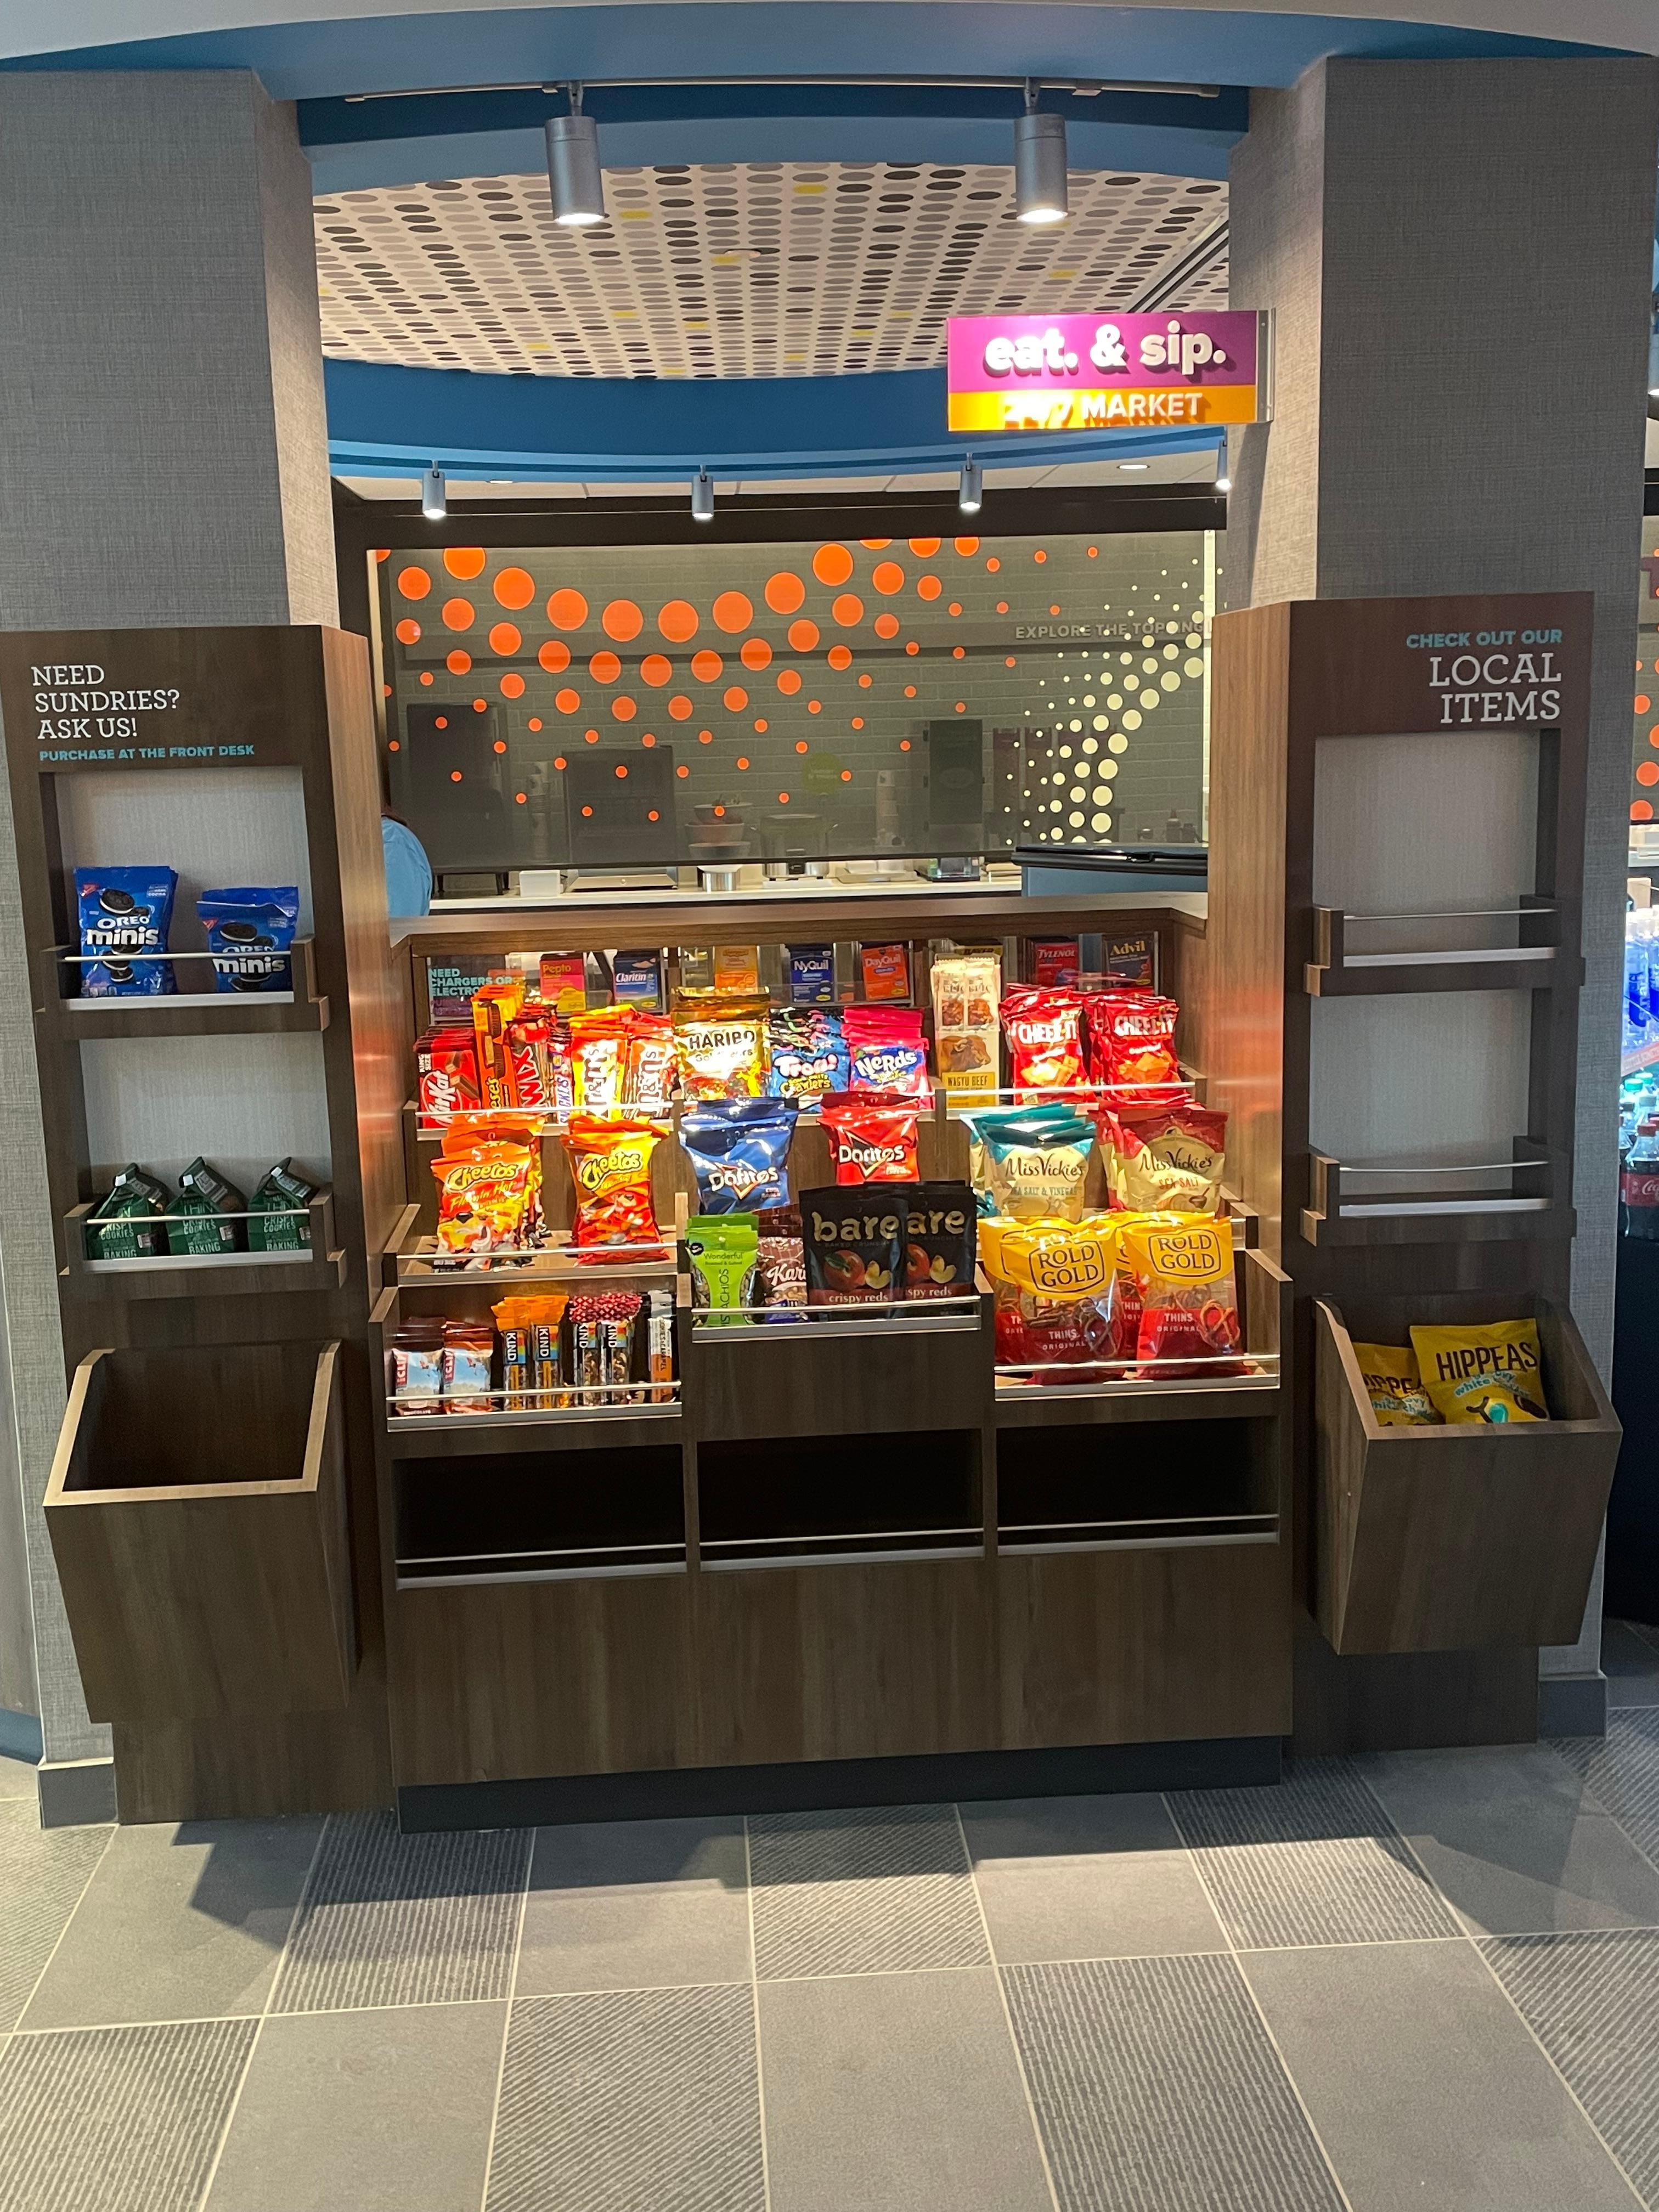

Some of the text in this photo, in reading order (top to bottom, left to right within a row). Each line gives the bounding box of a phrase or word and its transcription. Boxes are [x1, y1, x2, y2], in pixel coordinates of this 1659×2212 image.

[985, 320, 1227, 375] eat. & sip.
[1081, 392, 1203, 419] MARKET
[1015, 624, 1091, 640] EXPLORE
[1096, 623, 1127, 637] THE
[1406, 628, 1564, 649] CHECK OUT OUR
[31, 664, 105, 686] NEED
[1429, 652, 1562, 687] LOCAL
[35, 689, 180, 713] SUNDRIES?
[1440, 689, 1561, 724] ITEMS
[37, 717, 138, 740] ASK US!
[39, 744, 255, 761] PURCHASE AT THE FRONT DESK
[97, 916, 150, 930] OREO
[86, 926, 159, 946] minis
[1037, 949, 1076, 959] TYLENOL
[1109, 940, 1146, 956] Advil
[212, 956, 285, 973] minis
[542, 963, 572, 974] Pepto
[794, 959, 829, 974] NyQuil
[864, 954, 901, 968] DayQuil
[429, 968, 460, 978] NEED
[430, 976, 513, 987] CHARGERS OR
[615, 972, 647, 983] Claritin
[689, 1030, 756, 1049] HARIBO
[972, 1075, 988, 1086] BEEF
[839, 1144, 905, 1163] Doritos
[582, 1152, 641, 1190] Cheetos
[1005, 1153, 1084, 1182] Miss Vickie's
[447, 1163, 518, 1191] Cheetos
[1158, 1177, 1199, 1189] SEA SALT
[1024, 1186, 1040, 1196] SALT
[183, 1221, 217, 1235] COOKIES
[263, 1221, 296, 1233] COOKIES
[811, 1211, 900, 1242] bare
[907, 1209, 966, 1234] are
[100, 1228, 134, 1241] COOKIES
[1156, 1234, 1212, 1252] ROLD
[189, 1242, 221, 1255] BAKING
[266, 1242, 299, 1251] BAKING
[703, 1251, 743, 1260] Wonderful
[1037, 1245, 1094, 1269] ROLD
[1160, 1253, 1215, 1269] GOLD
[1041, 1264, 1099, 1288] GOLD
[828, 1291, 889, 1304] crispy reds
[929, 1286, 952, 1297] reds
[1164, 1313, 1193, 1322] THINS
[539, 1327, 549, 1357] KIND
[579, 1323, 589, 1349] KIND
[1048, 1328, 1077, 1341] THINS
[507, 1333, 517, 1361] KIND
[1042, 1341, 1086, 1351] ORIGINAL
[1436, 1341, 1537, 1381] HIPPEAS
[1455, 1378, 1491, 1396] white
